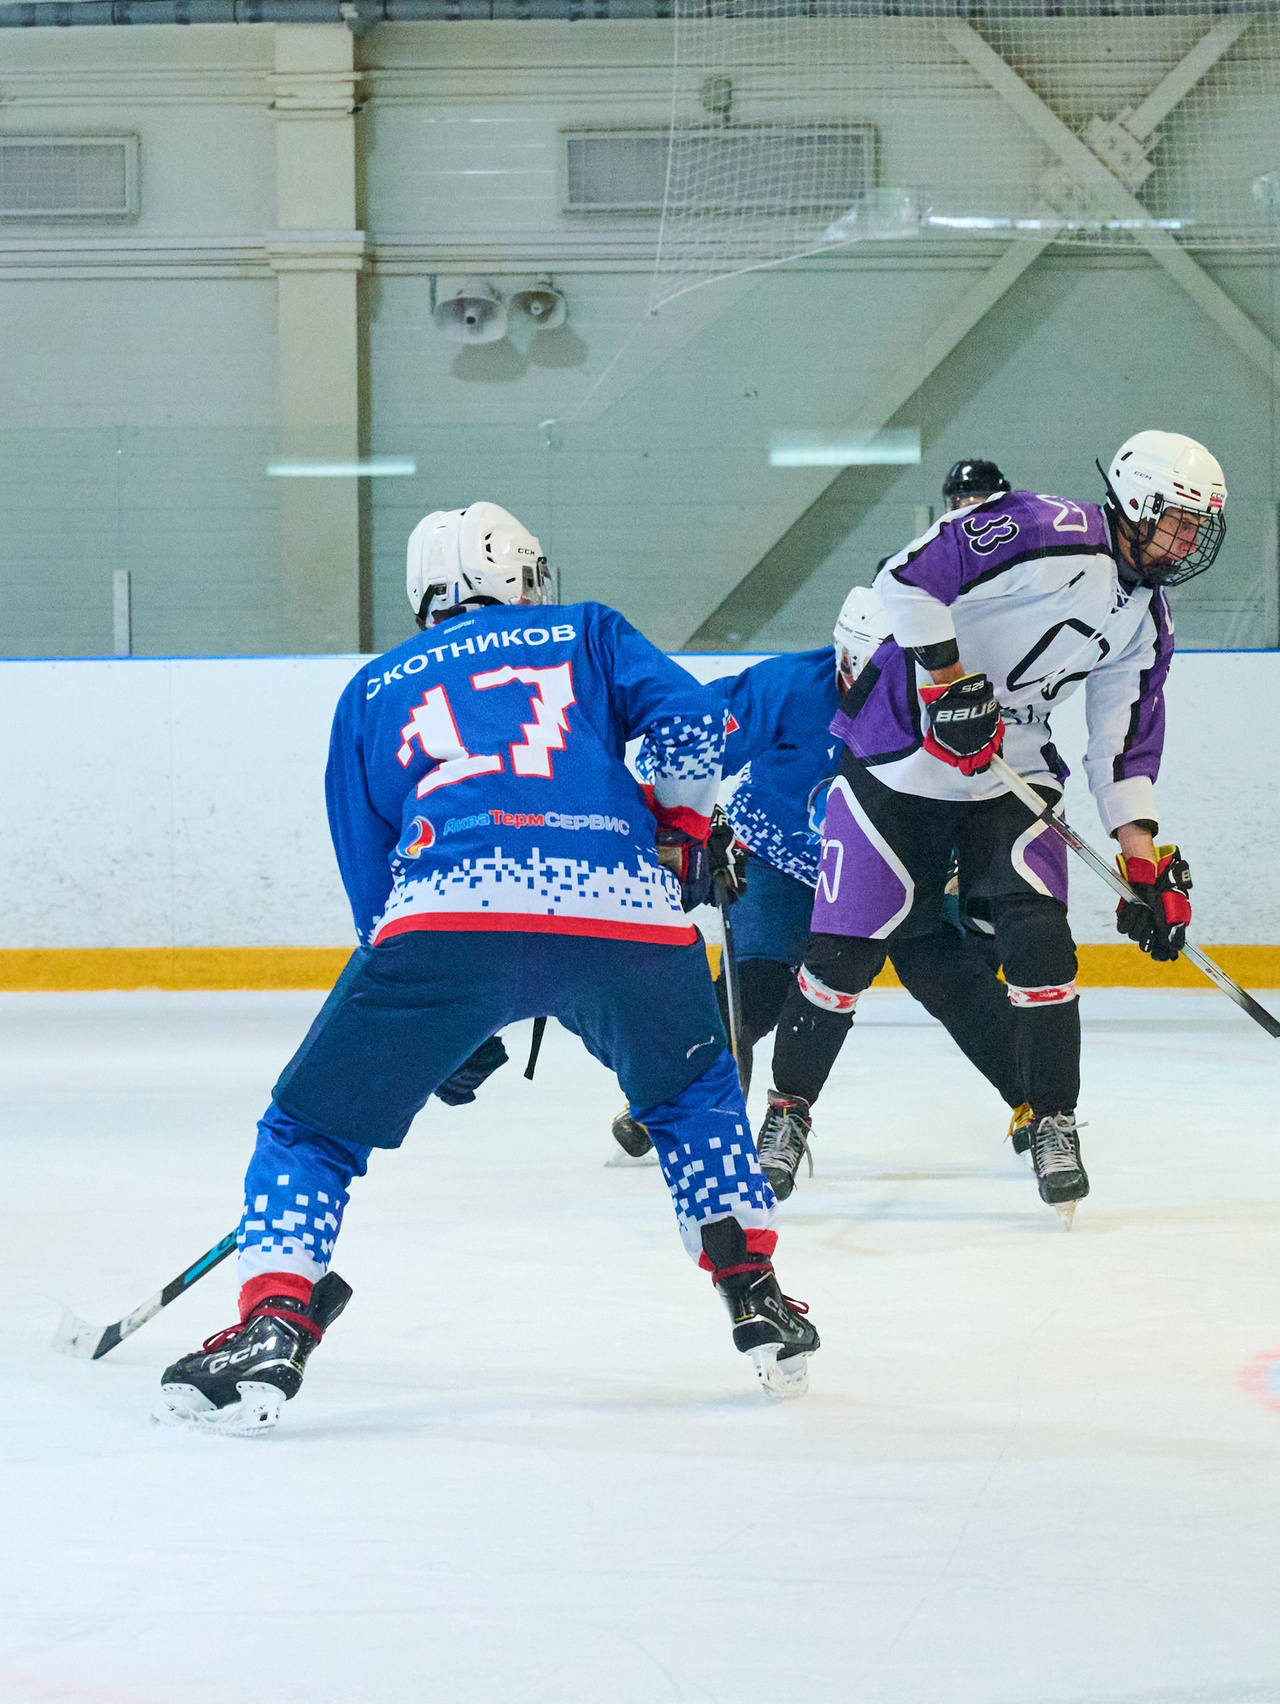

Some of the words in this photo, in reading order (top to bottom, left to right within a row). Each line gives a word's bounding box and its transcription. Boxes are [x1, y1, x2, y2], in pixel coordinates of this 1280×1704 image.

[366, 624, 577, 700] СКОТНИКОВ
[396, 661, 576, 799] 17
[936, 699, 999, 722] BAUE
[208, 1336, 278, 1375] CCM
